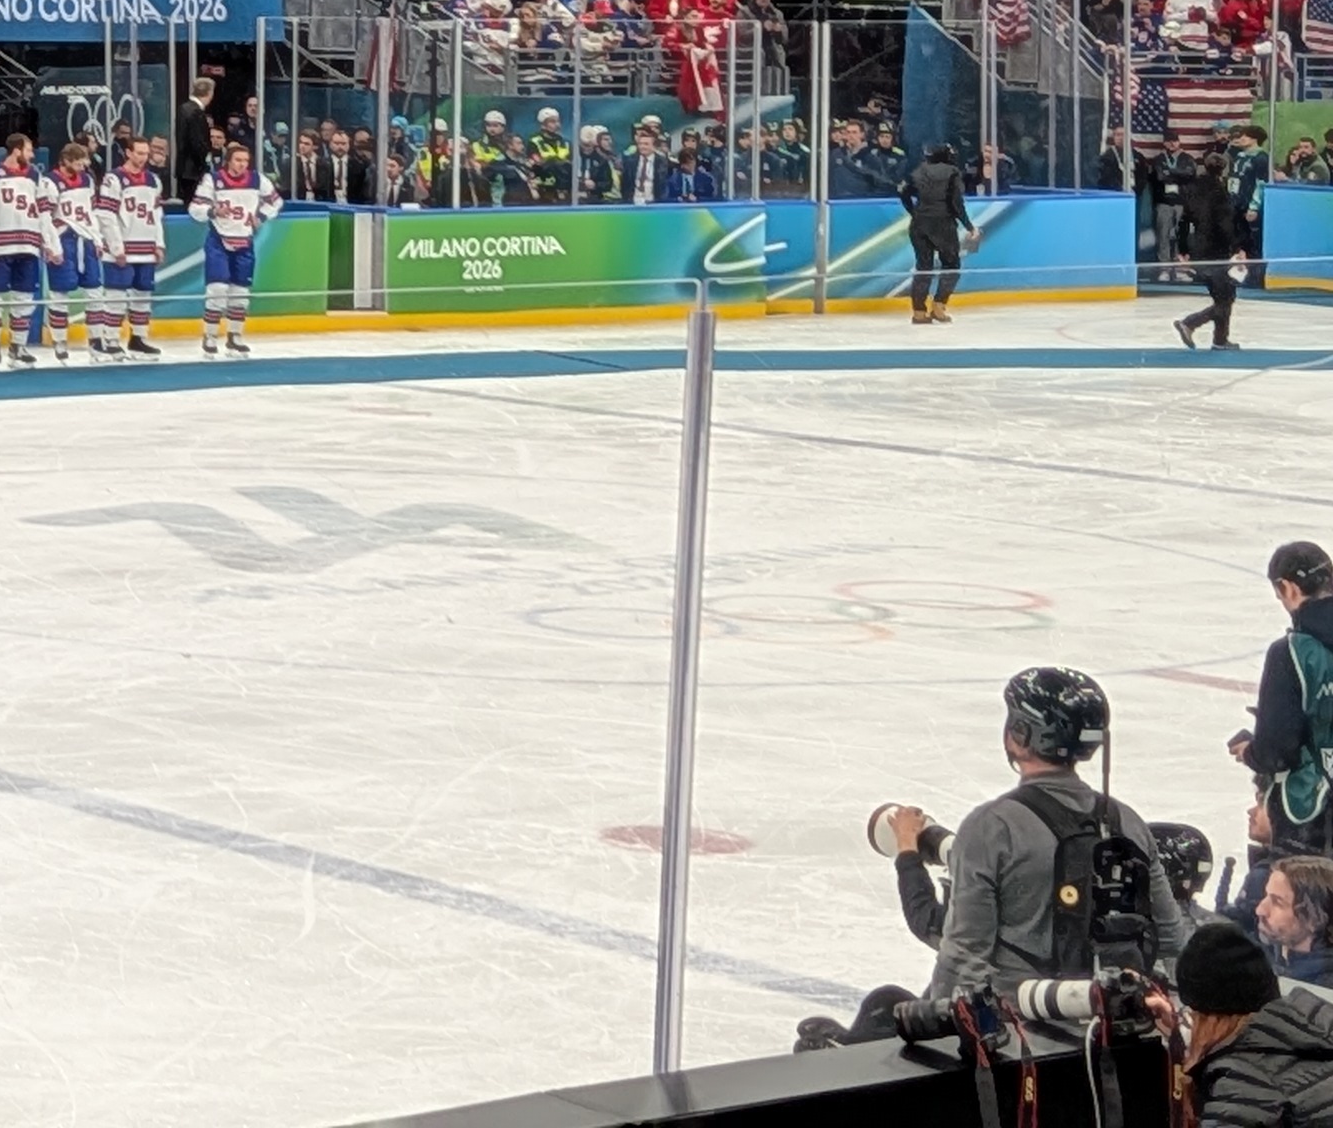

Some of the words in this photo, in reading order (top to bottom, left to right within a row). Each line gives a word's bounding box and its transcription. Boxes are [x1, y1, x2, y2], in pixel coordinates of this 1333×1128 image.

[1, 188, 39, 219] USA
[125, 197, 156, 226] USA
[397, 237, 480, 260] MILANO
[483, 235, 567, 257] CORTINA
[462, 259, 504, 280] 2026
